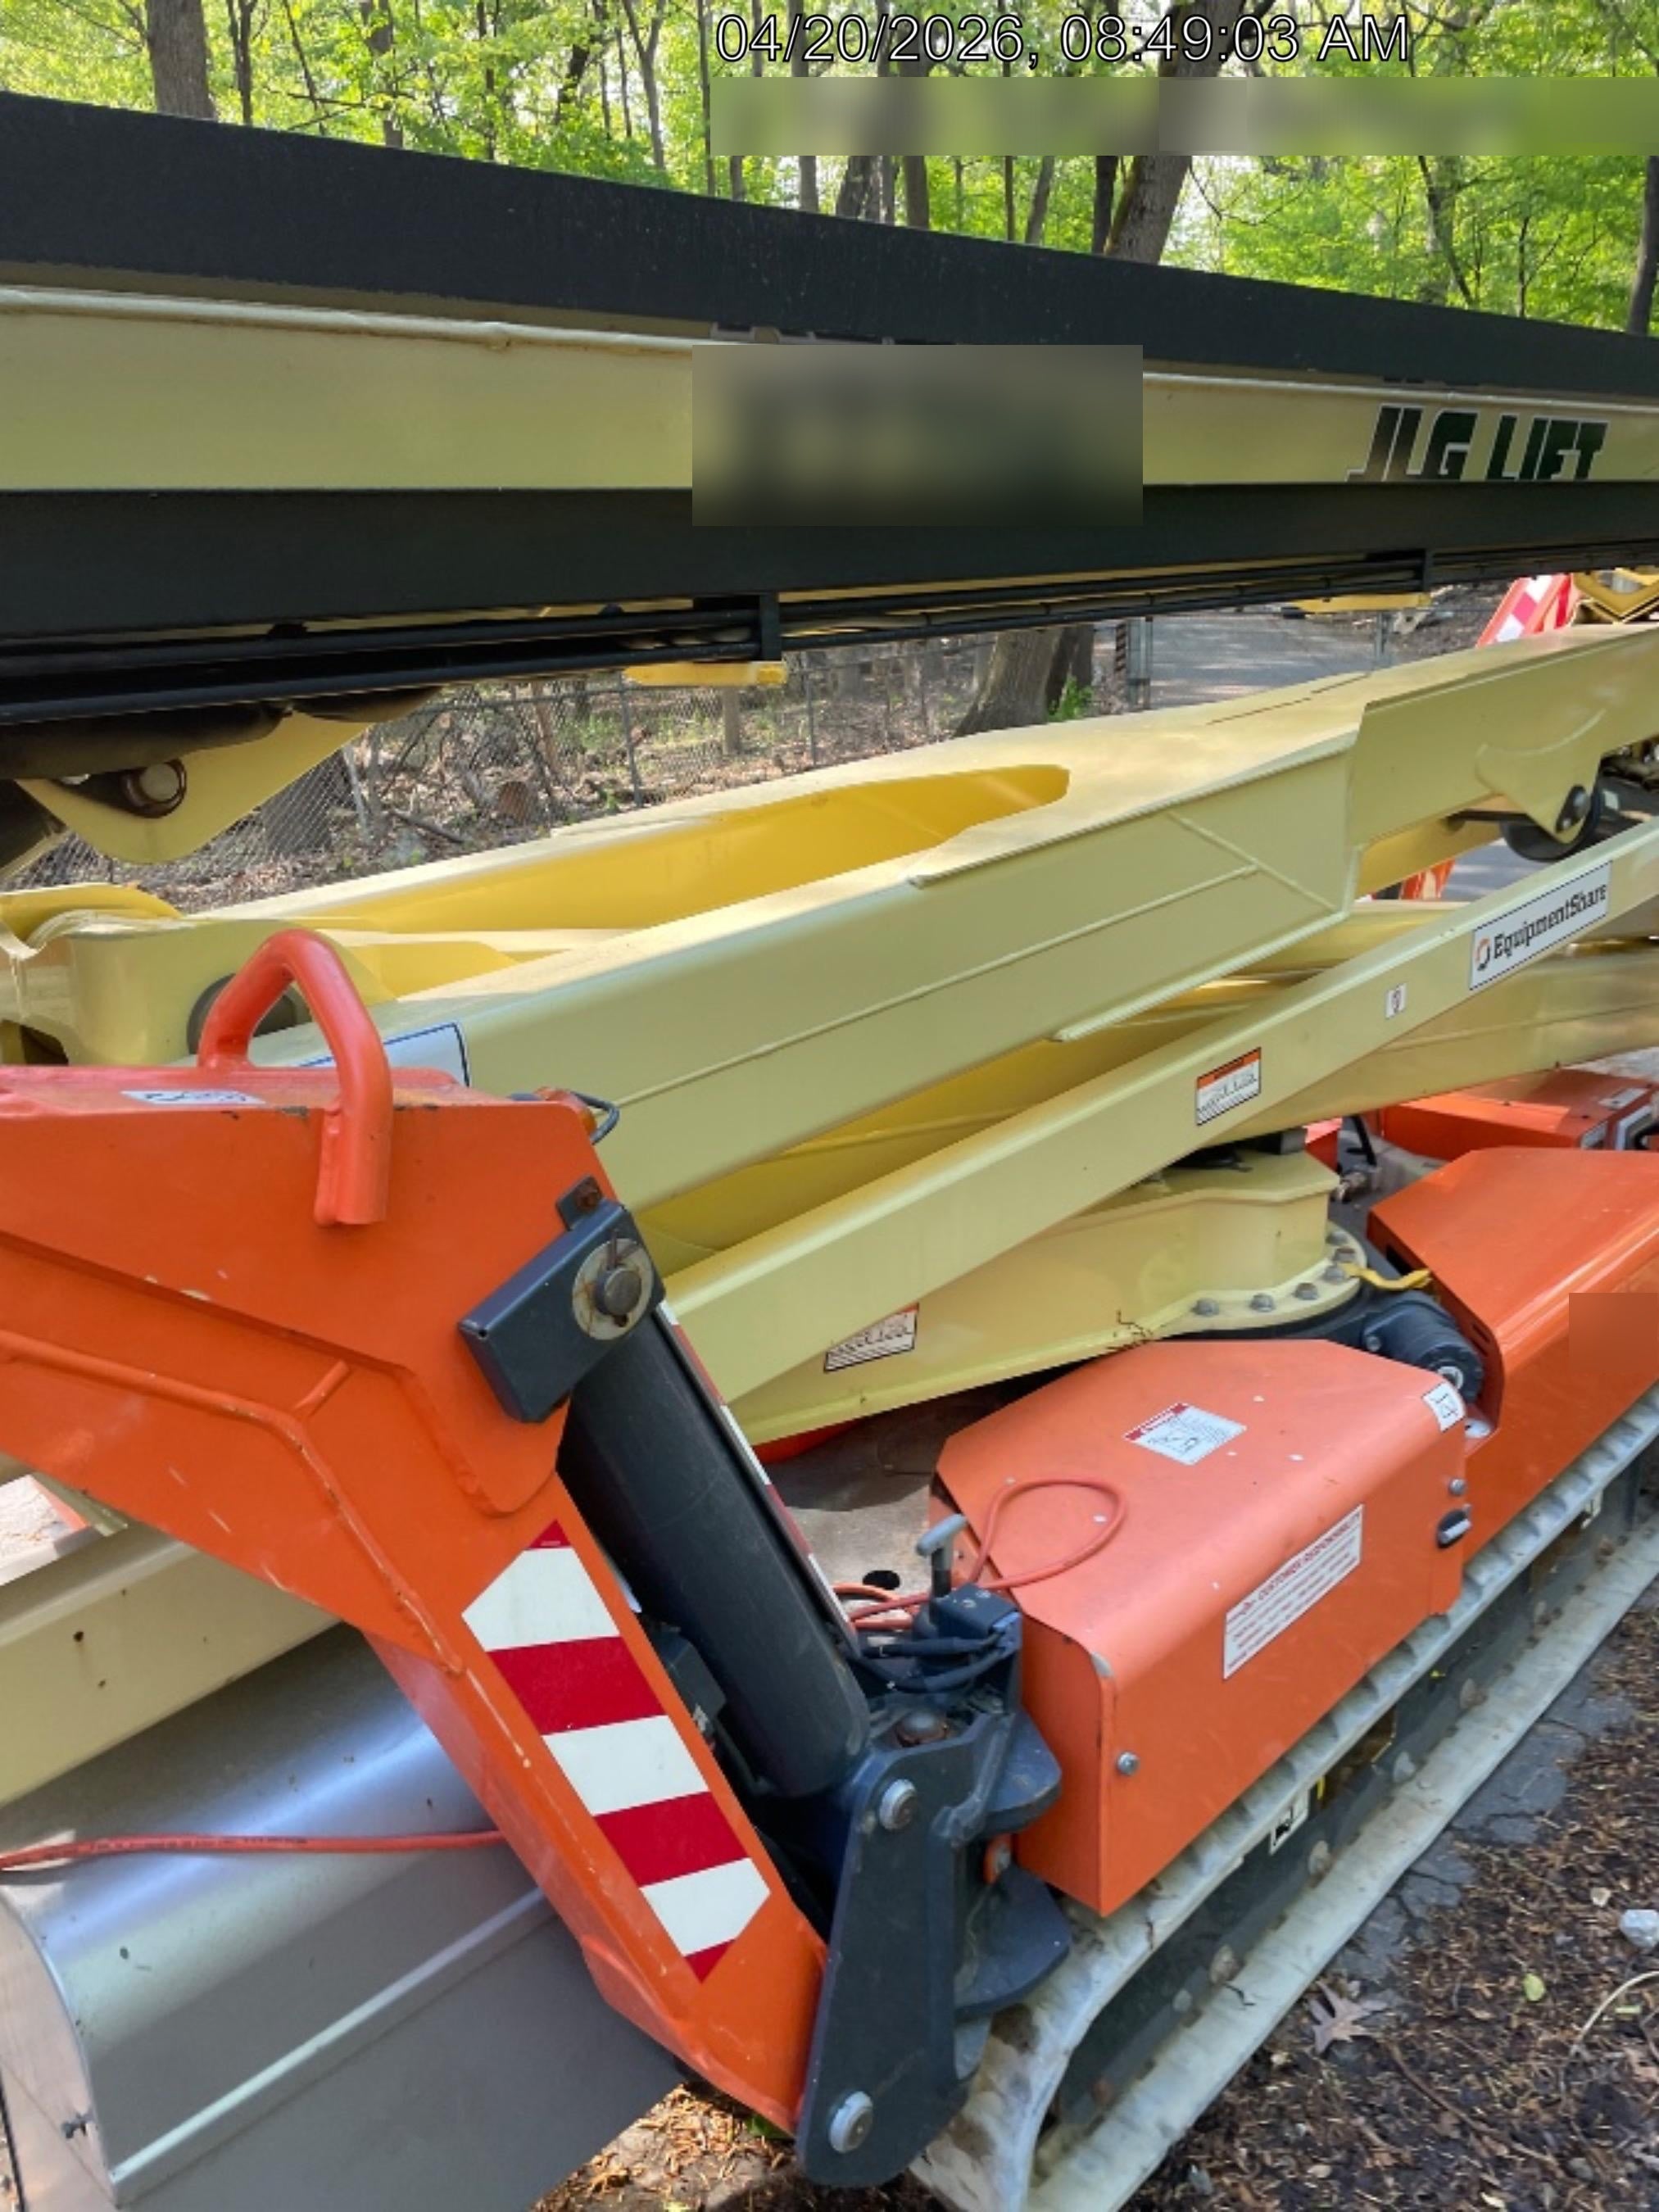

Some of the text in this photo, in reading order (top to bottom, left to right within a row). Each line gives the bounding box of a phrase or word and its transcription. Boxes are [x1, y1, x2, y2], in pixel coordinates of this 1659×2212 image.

[1345, 404, 1610, 482] JLG LIFT
[1494, 883, 1607, 959] EquipmentShare
